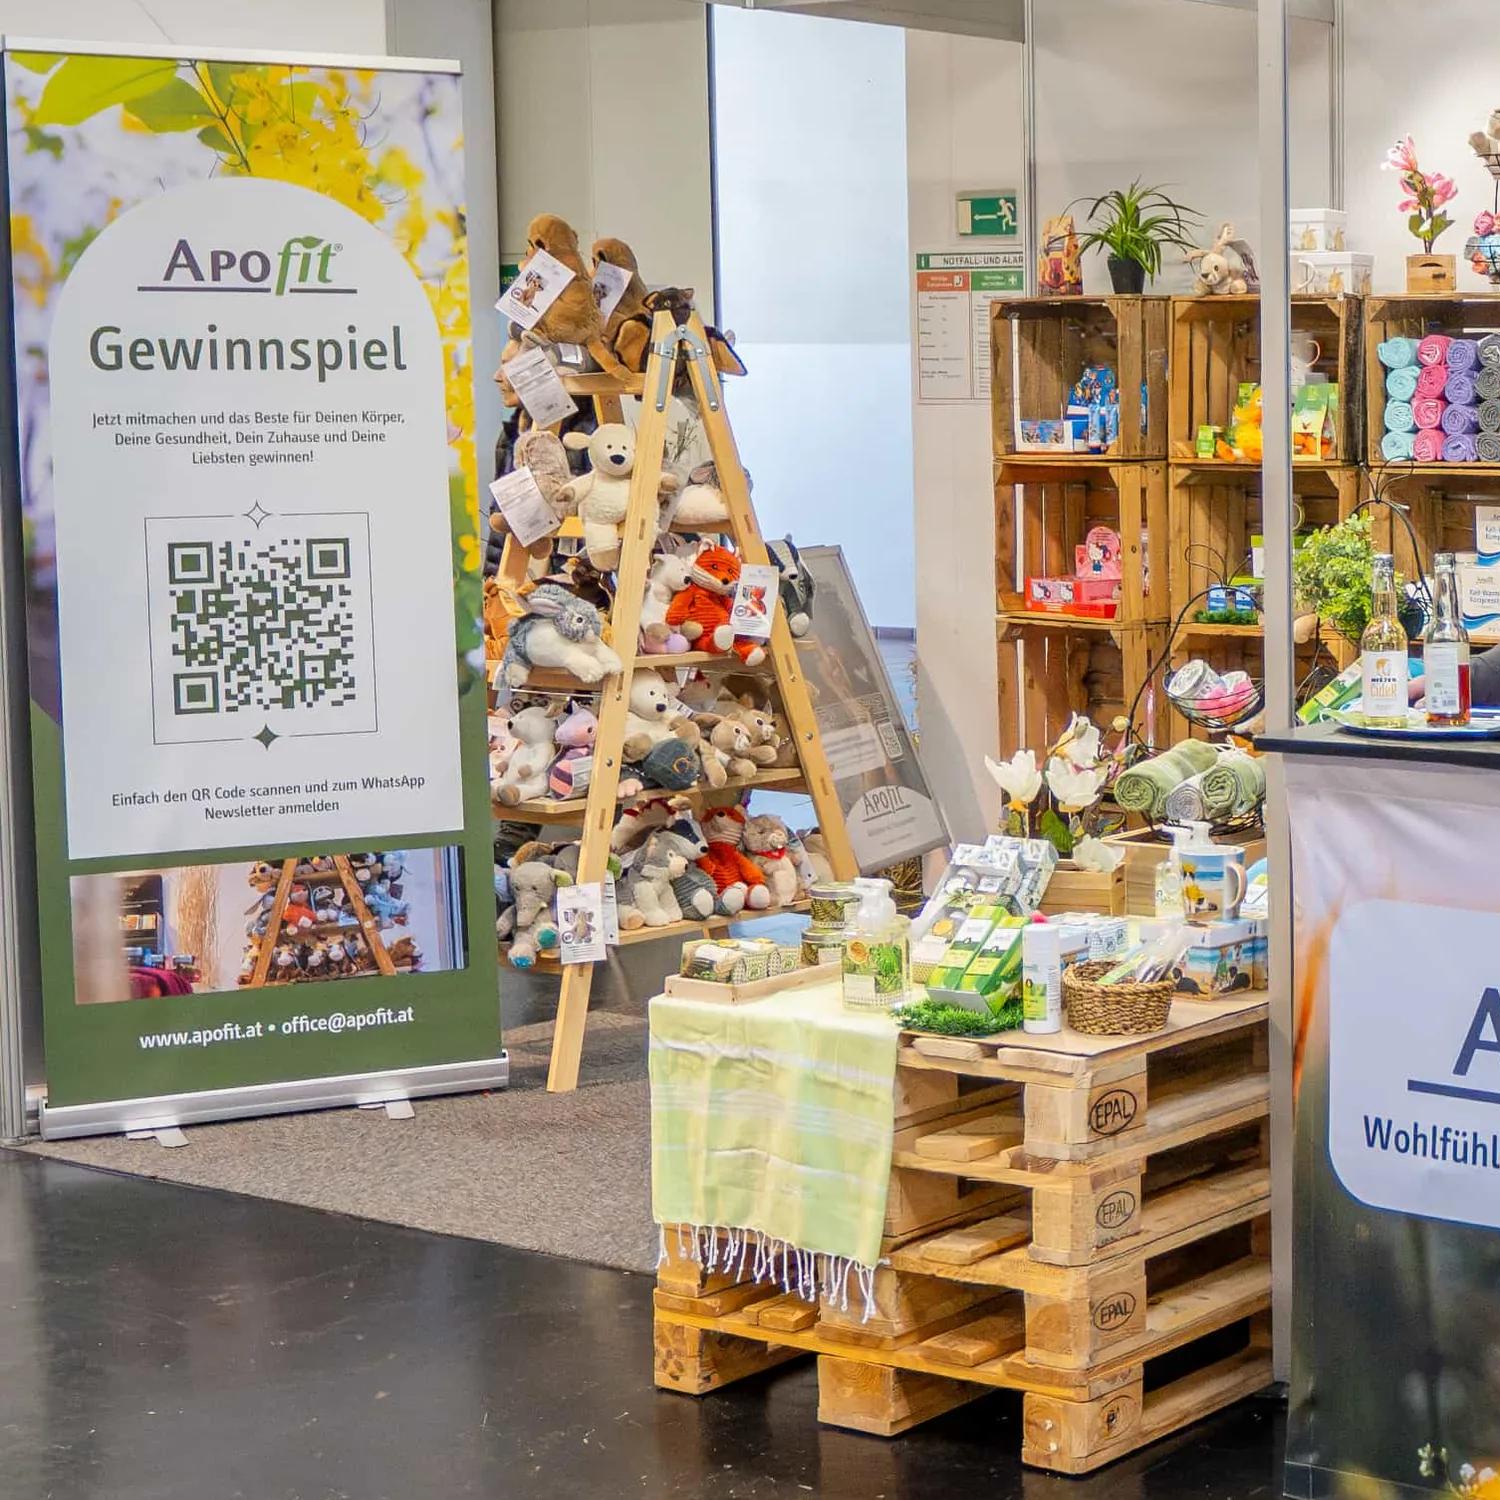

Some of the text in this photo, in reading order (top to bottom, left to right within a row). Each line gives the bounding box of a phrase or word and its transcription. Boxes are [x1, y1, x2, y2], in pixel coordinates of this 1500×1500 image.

[90, 324, 407, 382] Gewinnspiel
[92, 410, 405, 428] Jetzt mitmachen und das Beste für Deinen Körper,
[115, 430, 386, 446] Deine Gesundheit, Dein Zuhause und Deine
[192, 451, 314, 466] Liebsten gewinnen!
[112, 774, 425, 807] Einfach den QR Code scannen und zum WhatsApp
[205, 800, 339, 820] Newsletter anmelden
[139, 1006, 414, 1049] www.apofit.at office@apofit.at
